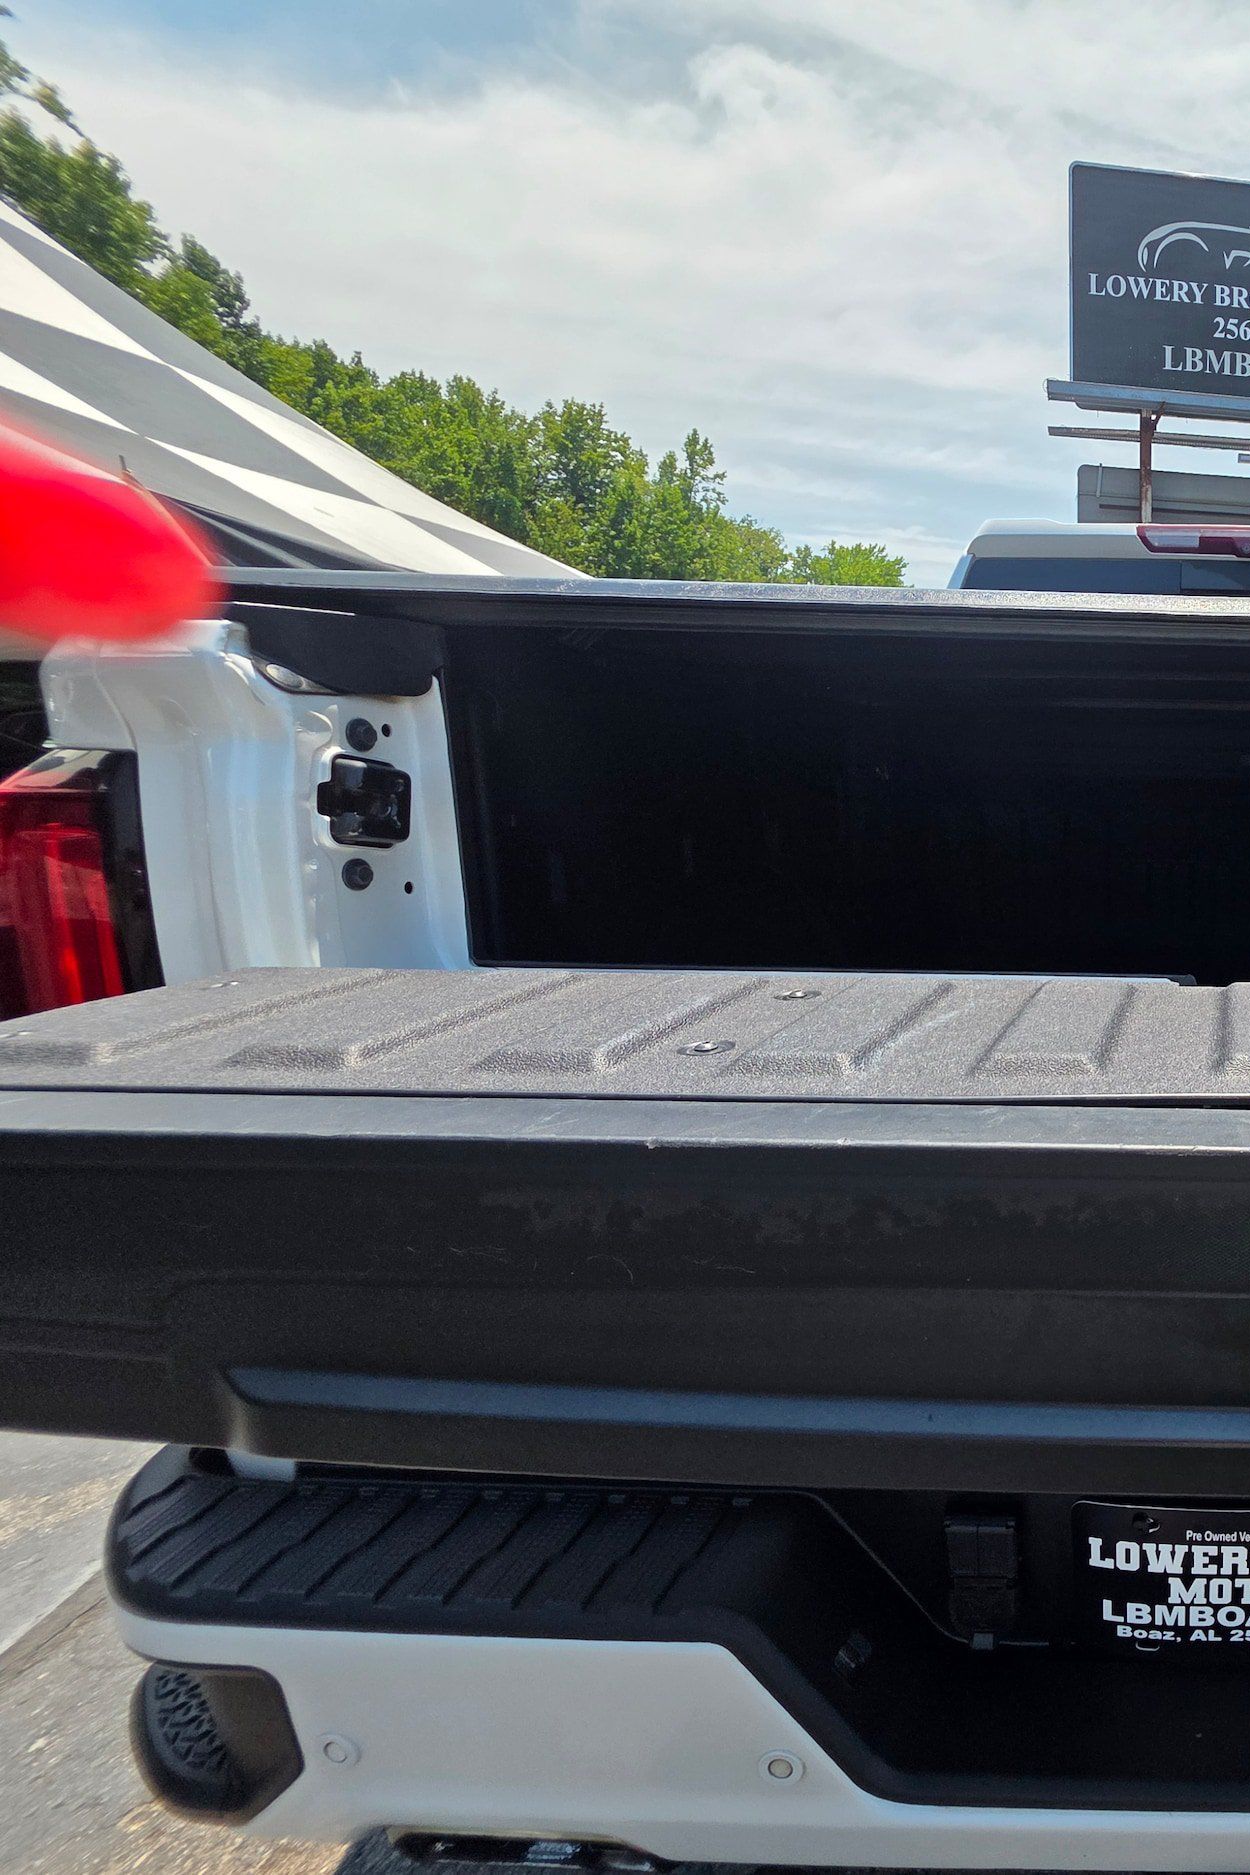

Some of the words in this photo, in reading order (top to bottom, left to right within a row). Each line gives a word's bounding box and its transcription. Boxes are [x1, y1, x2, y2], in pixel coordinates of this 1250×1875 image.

[1088, 273, 1208, 305] LOWERY
[1186, 1530, 1202, 1542] Pre
[1204, 1530, 1237, 1542] Owned
[1116, 1625, 1182, 1643] Boaz,
[1190, 1629, 1222, 1642] AL
